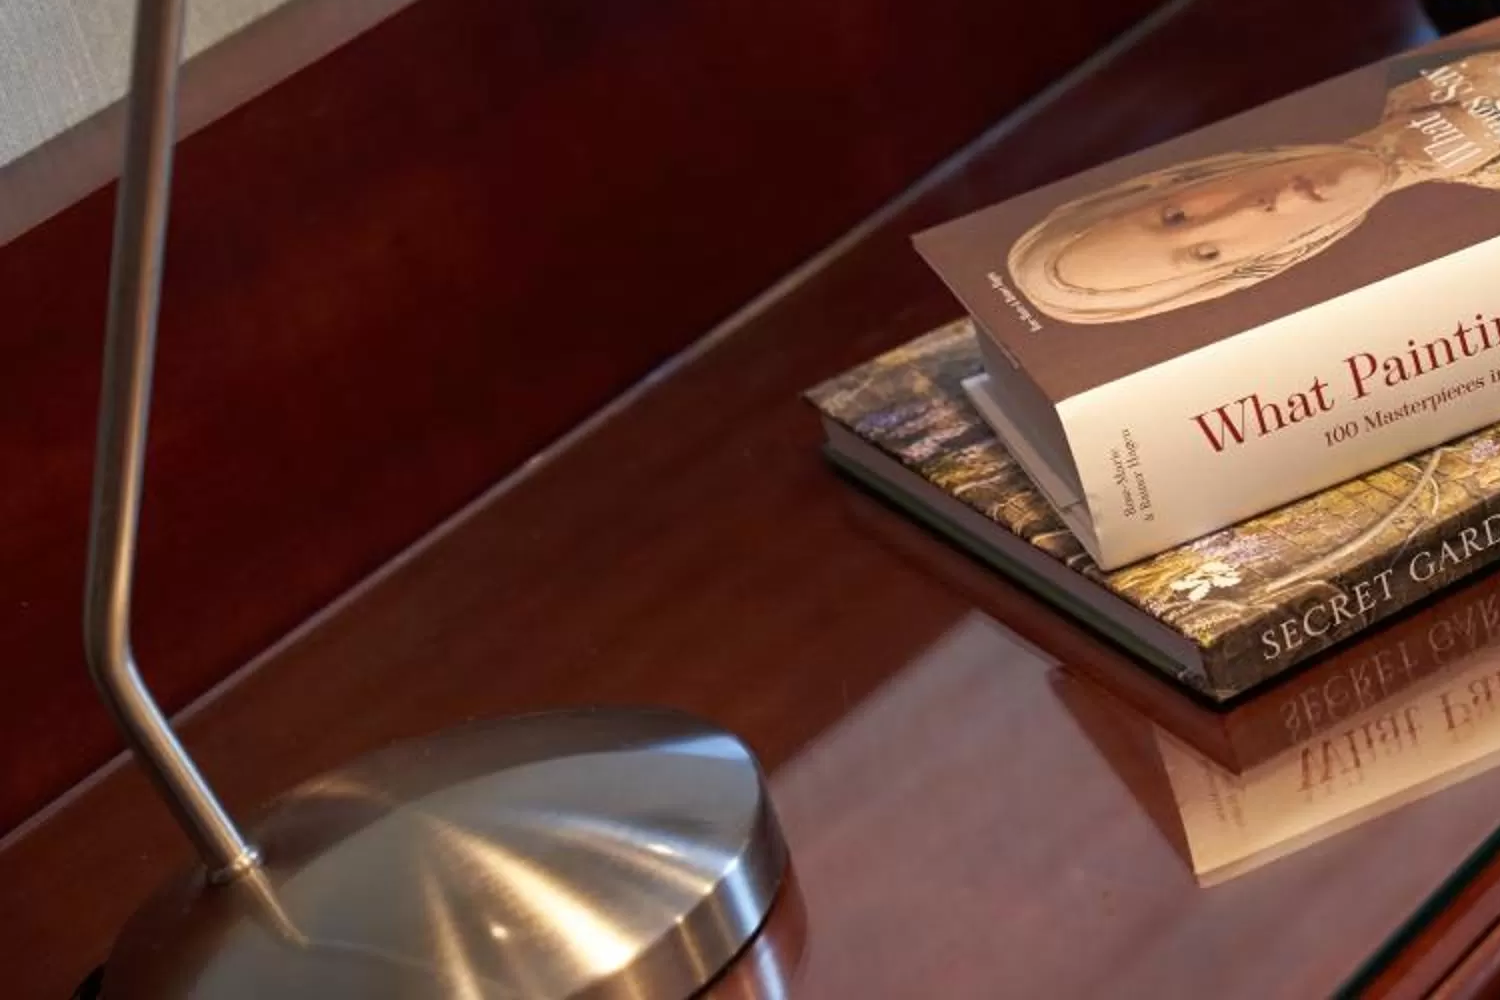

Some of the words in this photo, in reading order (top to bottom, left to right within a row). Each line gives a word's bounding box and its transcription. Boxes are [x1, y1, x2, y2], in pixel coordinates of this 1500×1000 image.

[1189, 375, 1335, 453] What
[1323, 422, 1360, 447] 100
[1363, 375, 1486, 433] Masterpieces
[1260, 569, 1395, 660] SECRET
